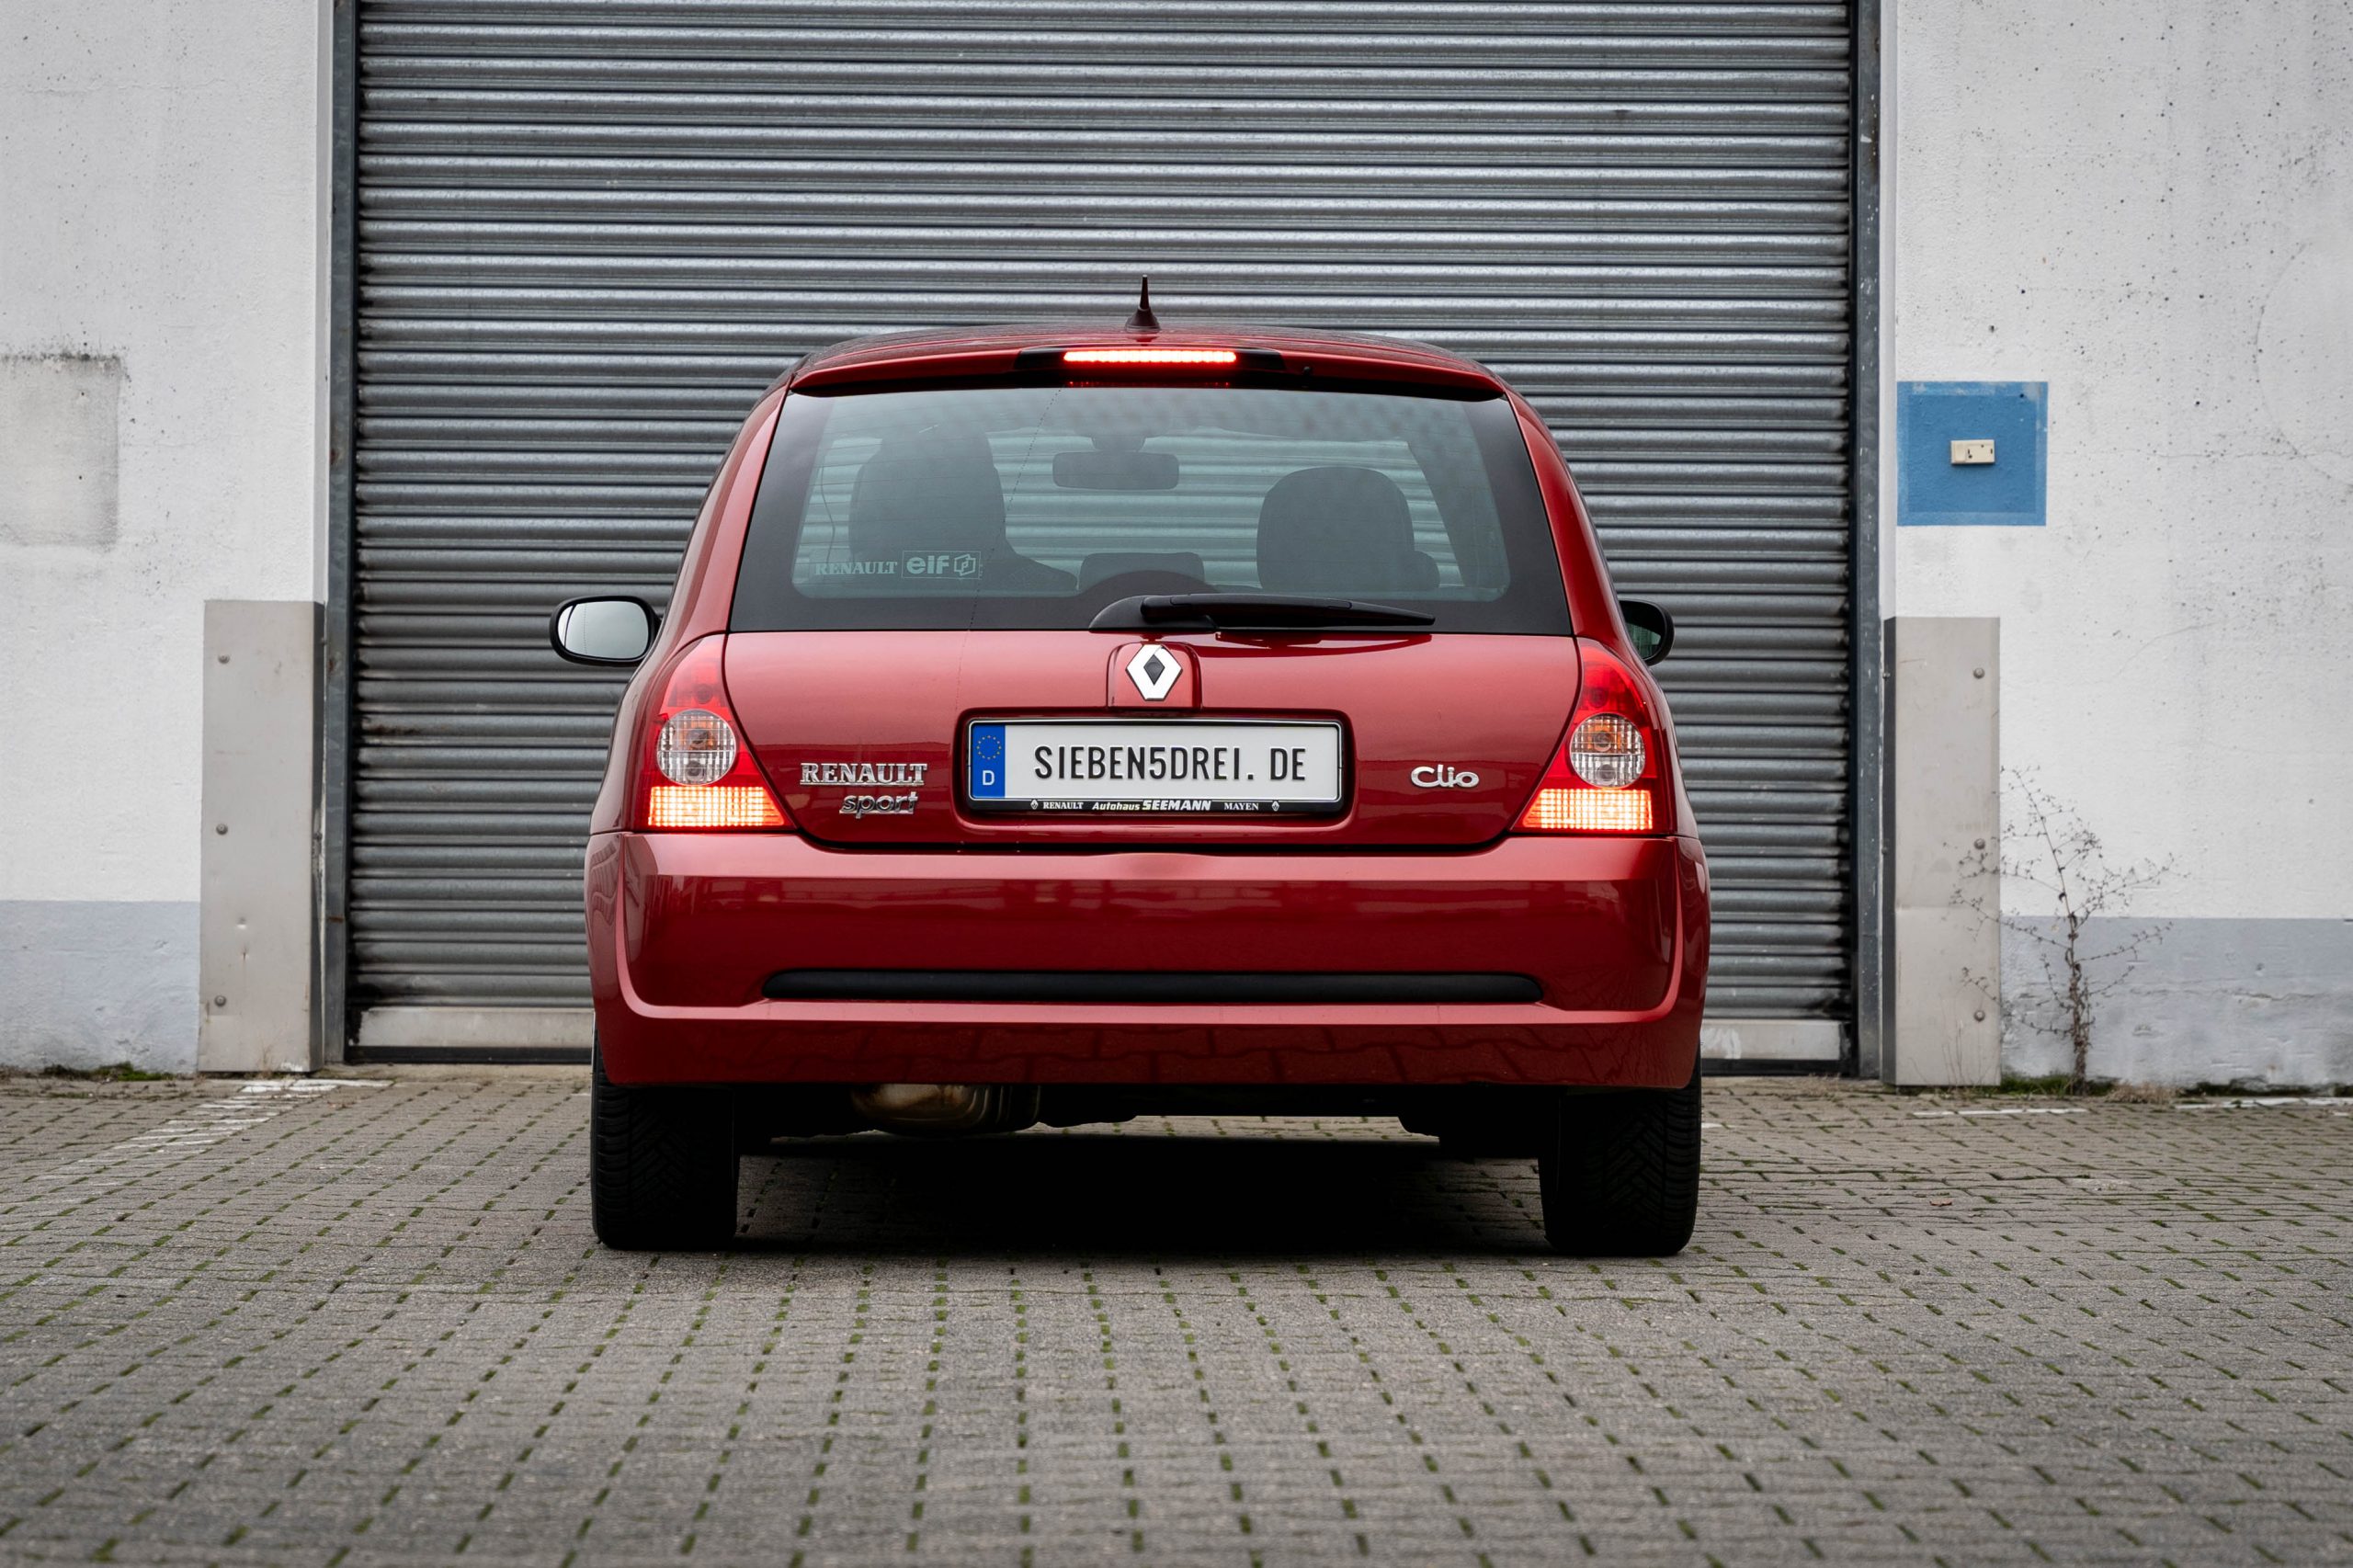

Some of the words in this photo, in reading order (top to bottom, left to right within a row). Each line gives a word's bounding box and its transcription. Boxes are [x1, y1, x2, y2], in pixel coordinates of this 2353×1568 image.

[814, 562, 897, 574] RENAULT
[906, 555, 949, 574] elf
[1034, 745, 1254, 780] SIEBEN5DREI.
[1269, 747, 1306, 781] DE
[800, 763, 927, 783] RENAULT
[982, 770, 995, 786] D
[1411, 764, 1480, 788] Clio
[841, 790, 918, 819] sport
[1042, 801, 1084, 811] RENAULT
[1092, 801, 1140, 812] Autohaus
[1142, 799, 1211, 812] SEEMANN
[1223, 802, 1259, 812] MAYEN
